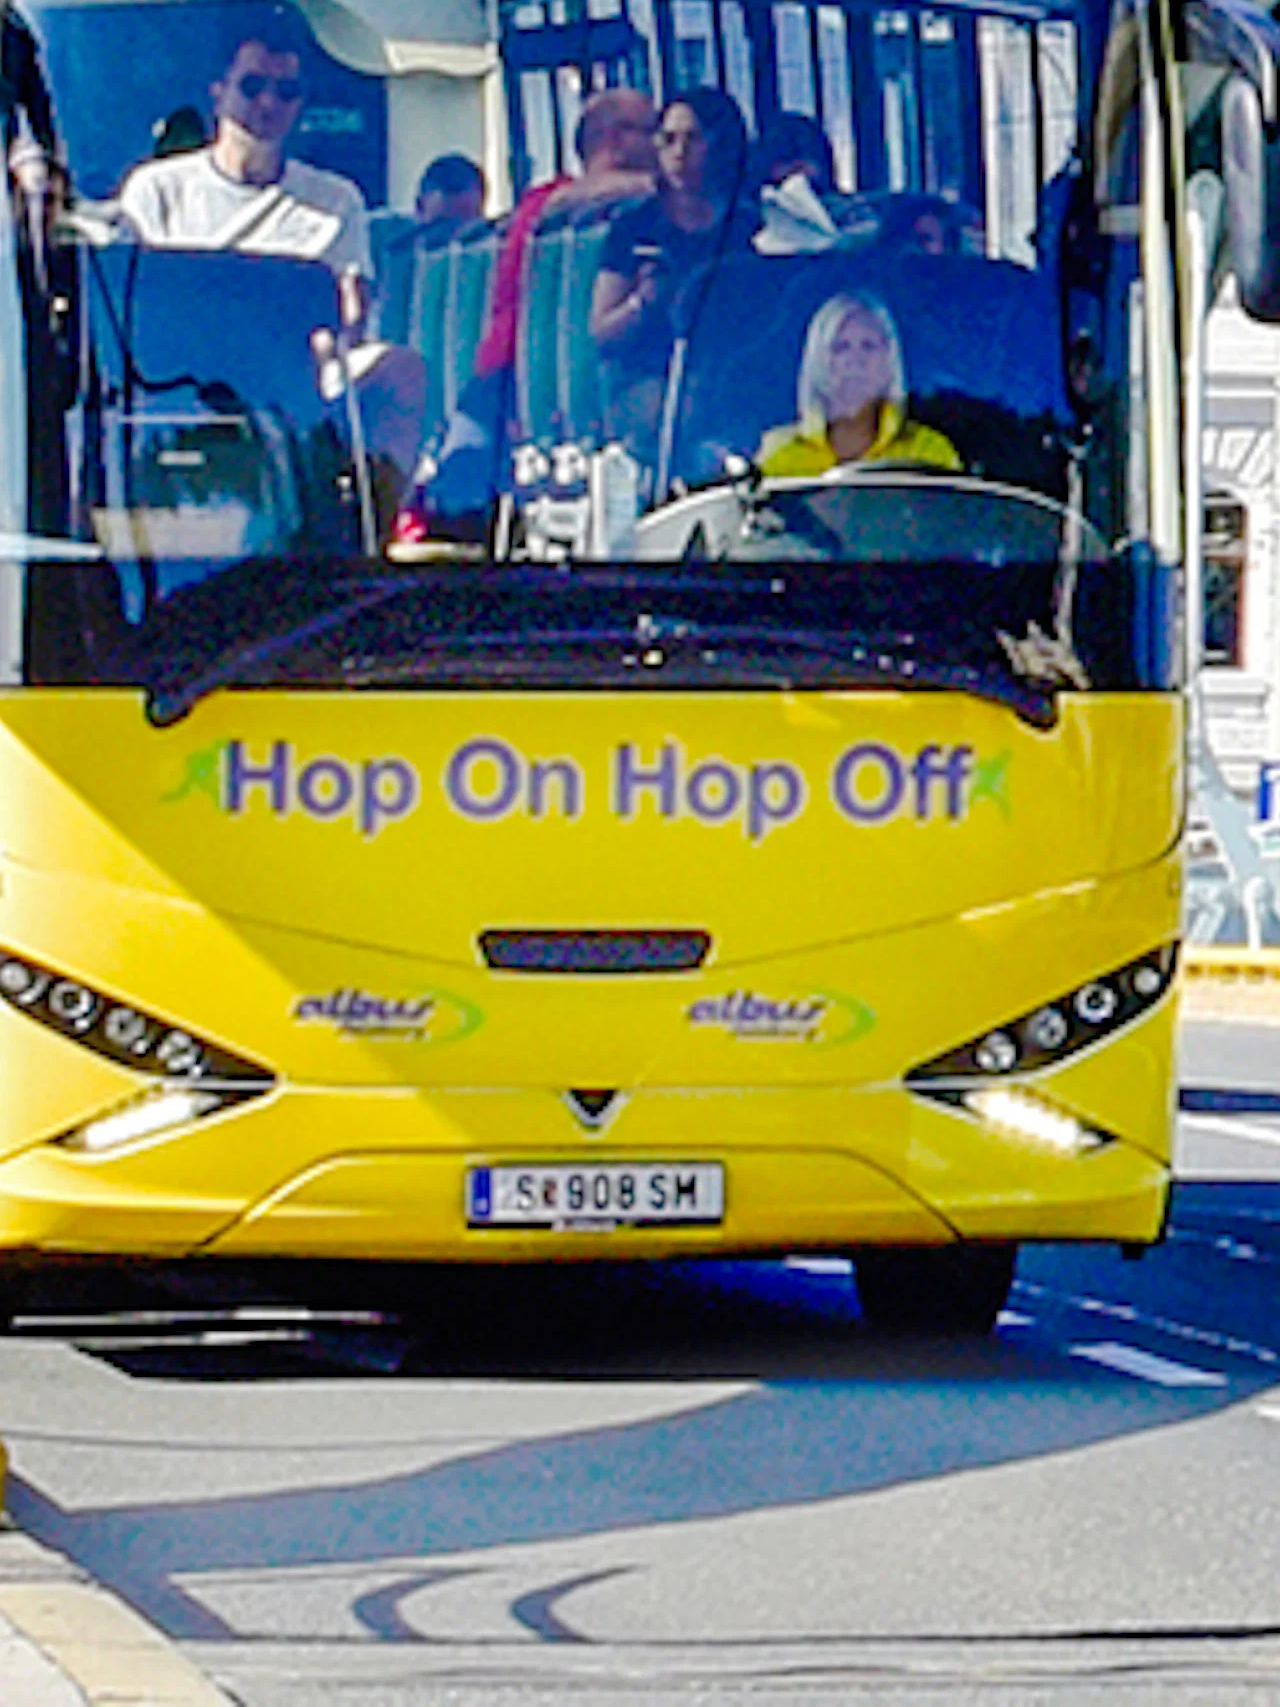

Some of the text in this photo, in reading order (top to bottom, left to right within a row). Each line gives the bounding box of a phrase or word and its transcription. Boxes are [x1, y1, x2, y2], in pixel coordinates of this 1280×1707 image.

[225, 736, 974, 841] Hop On Hop Off
[566, 1174, 636, 1210] 908
[649, 1173, 697, 1209] SM
